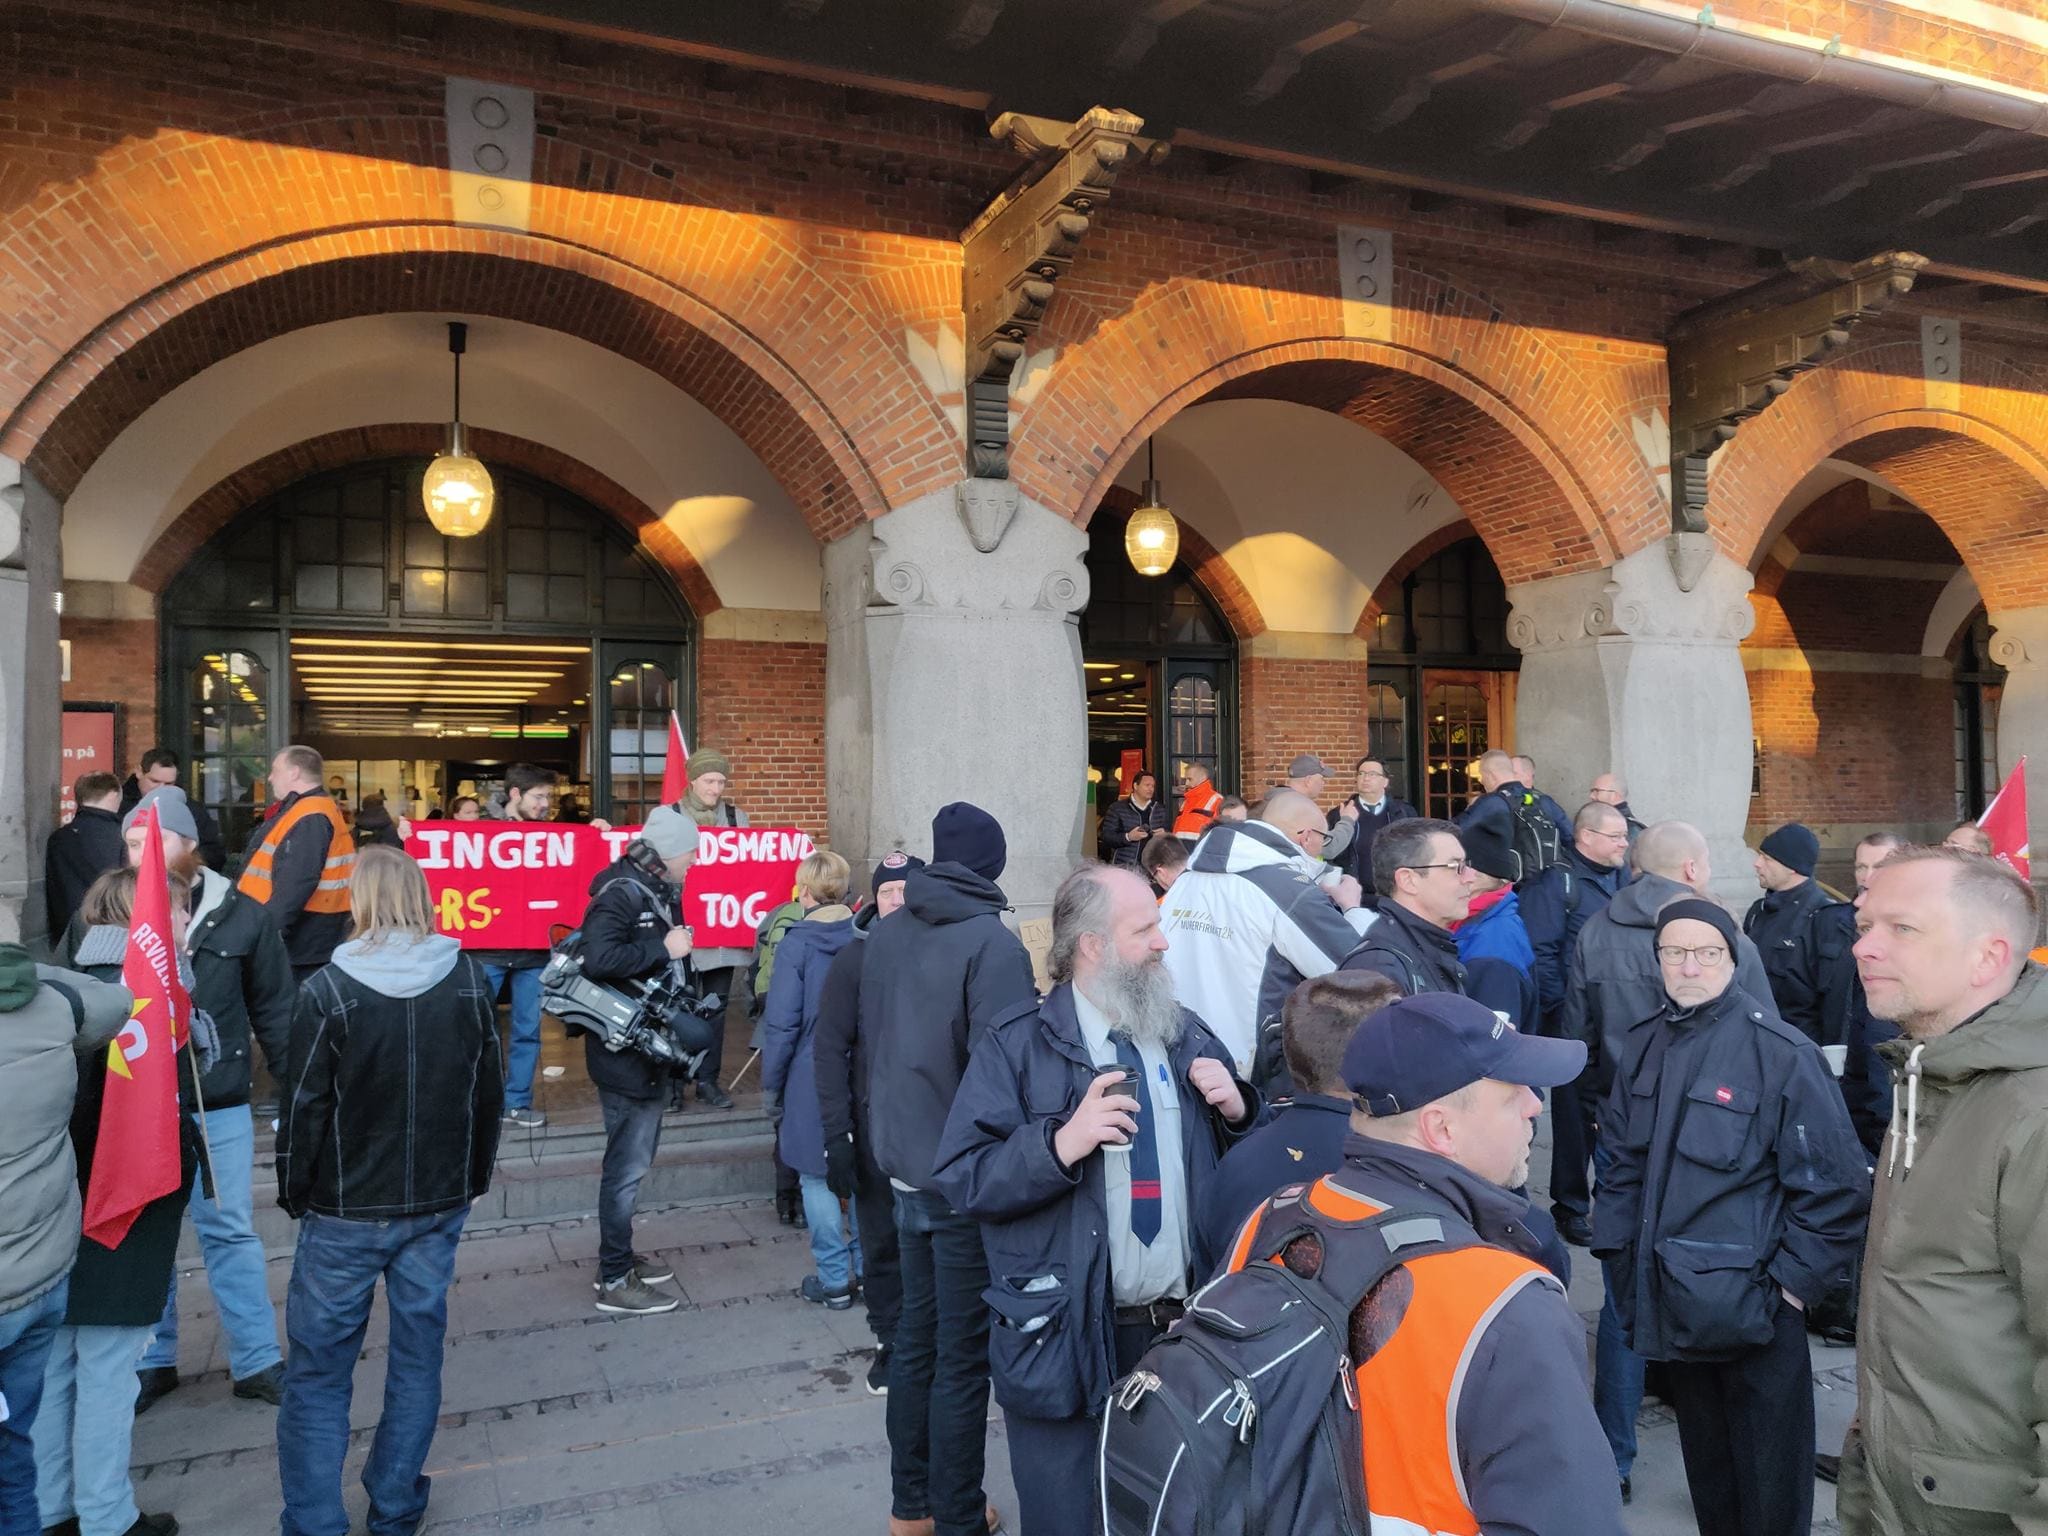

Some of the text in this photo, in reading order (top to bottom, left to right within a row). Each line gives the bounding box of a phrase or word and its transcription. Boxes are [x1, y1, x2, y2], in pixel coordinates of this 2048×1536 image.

[76, 746, 95, 760] på
[416, 829, 575, 869] INGEN
[699, 891, 768, 929] TOG
